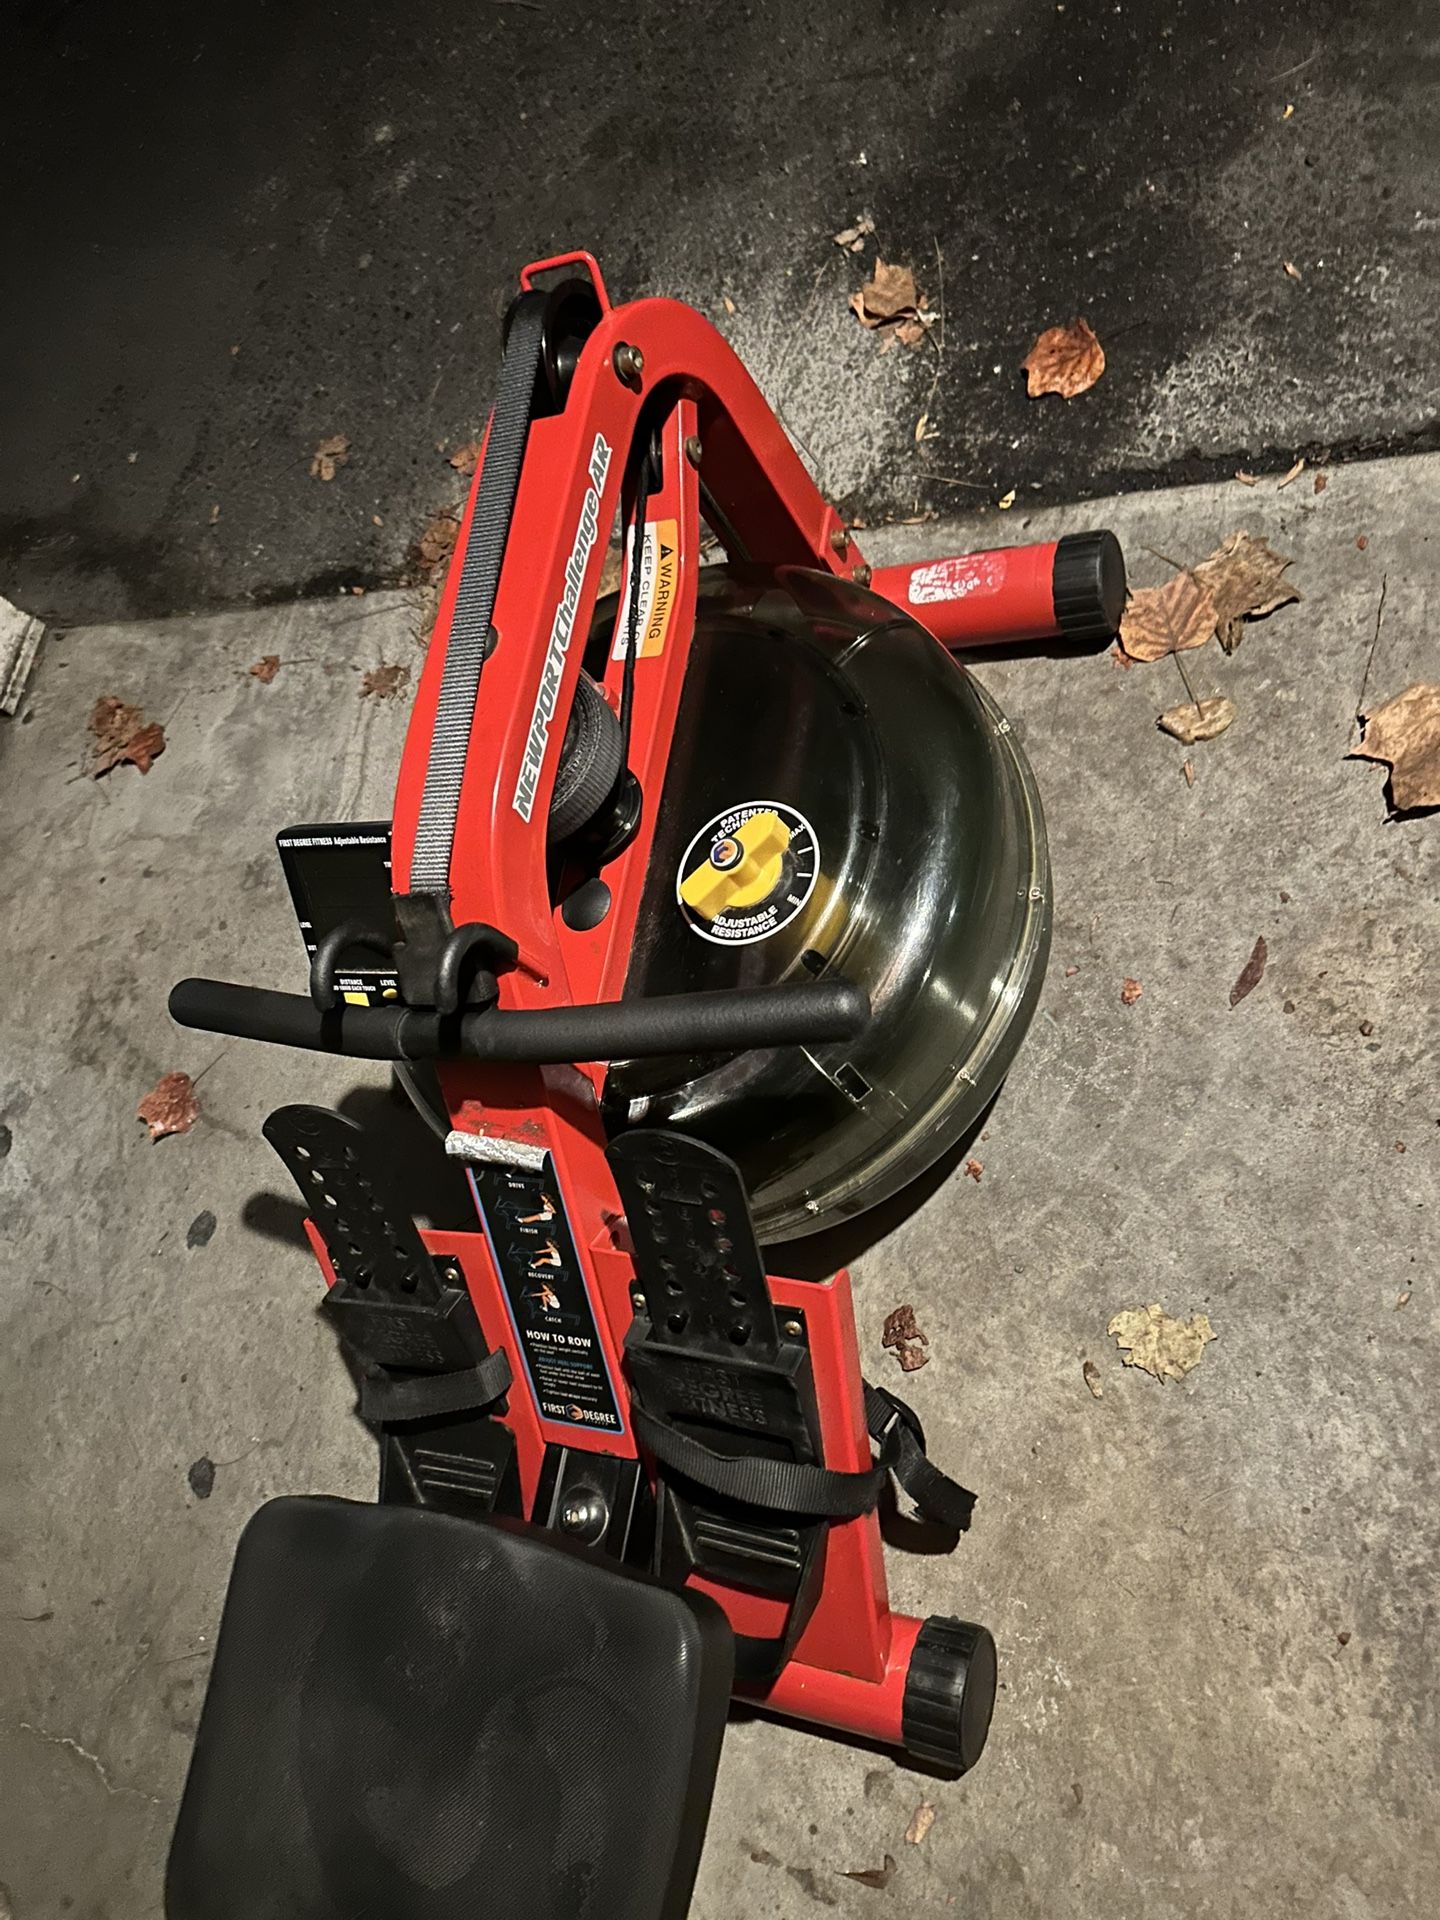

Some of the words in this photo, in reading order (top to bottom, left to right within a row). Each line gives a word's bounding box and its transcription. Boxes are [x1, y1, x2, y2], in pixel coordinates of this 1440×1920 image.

[590, 434, 611, 495] AR
[643, 534, 652, 575] KEEP
[648, 562, 673, 640] WARNING
[279, 838, 293, 847] FIRST
[293, 838, 312, 847] DEGREE
[312, 837, 333, 846] FITNESS
[334, 836, 359, 847] Adjustable
[359, 836, 386, 844] Resistance
[789, 823, 806, 840] MAX
[711, 904, 778, 929] ADJUSTABLE
[711, 916, 777, 938] RESISTANCE
[527, 1271, 554, 1280] RECOVERY
[526, 1330, 550, 1342] HOW
[552, 1333, 566, 1344] TO
[567, 1336, 592, 1347] ROW
[541, 1401, 566, 1415] FIRST
[583, 1409, 617, 1424] DEGREE
